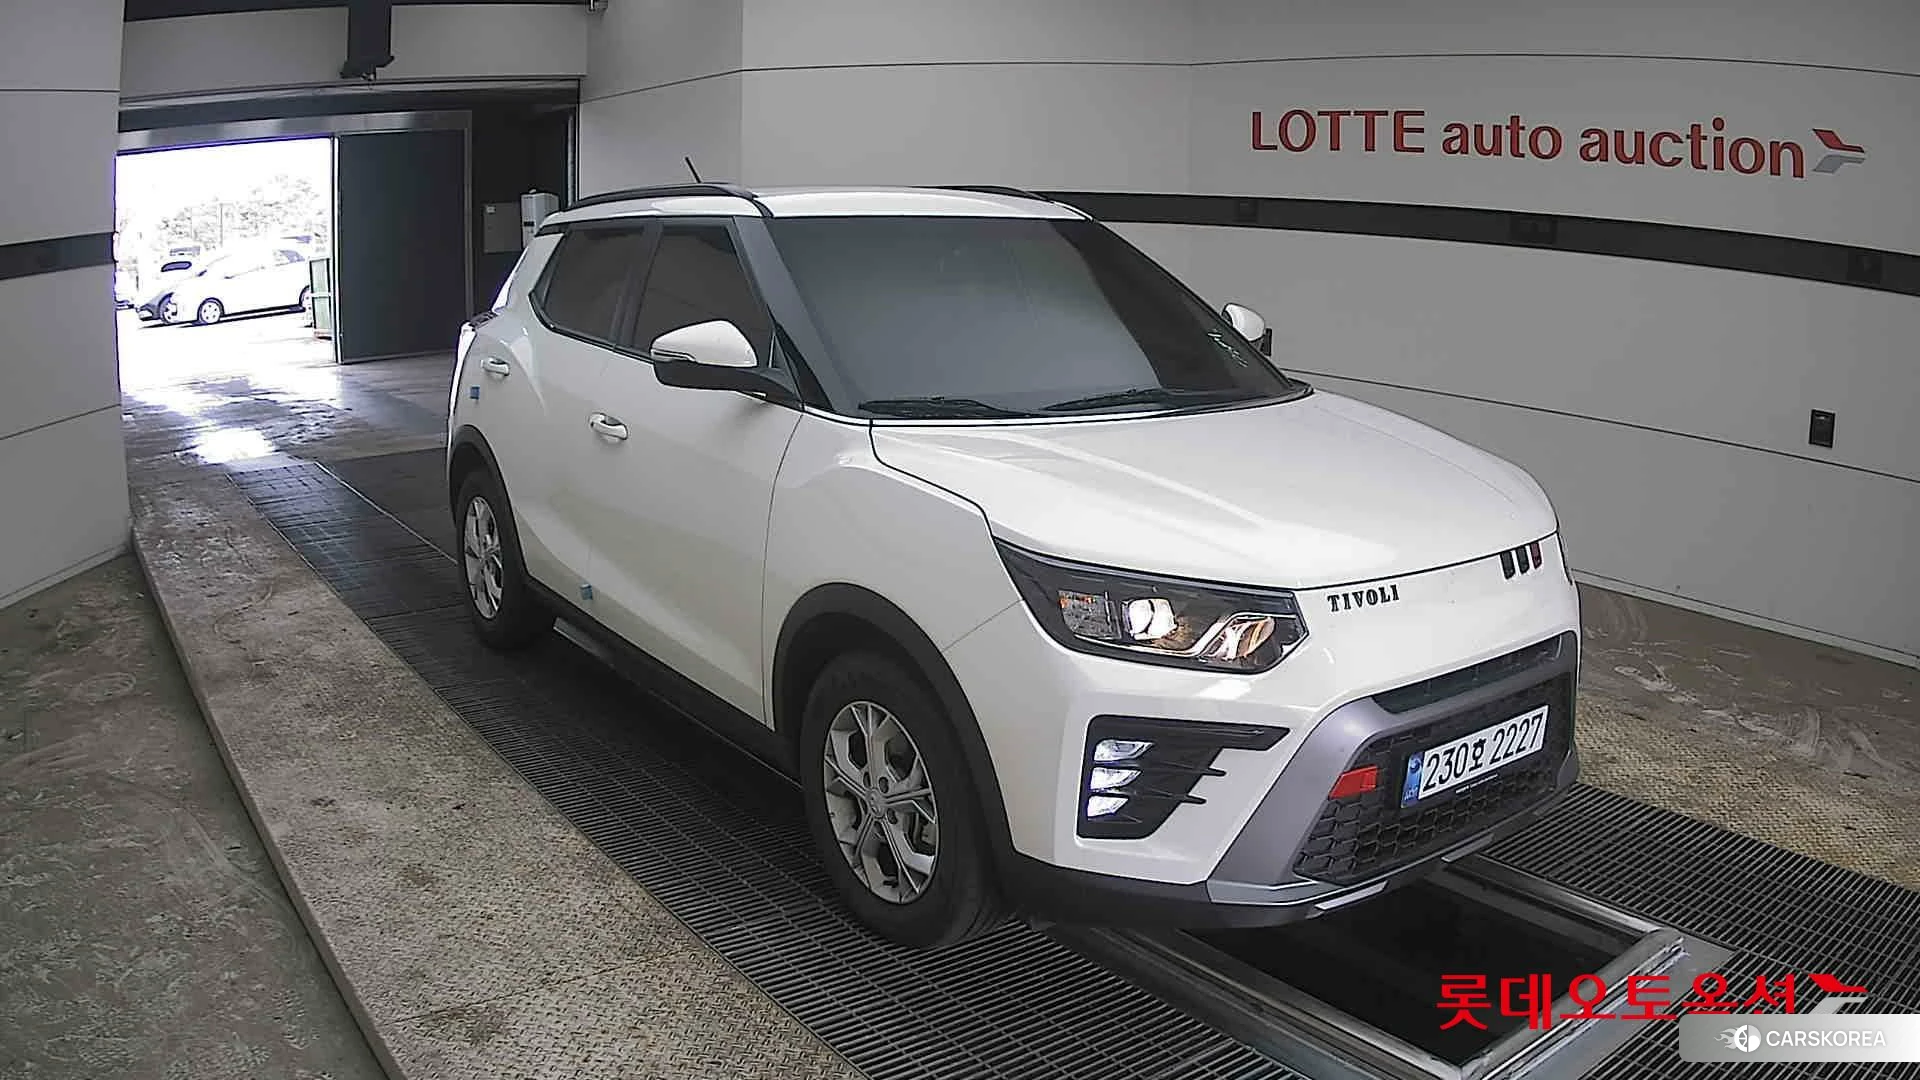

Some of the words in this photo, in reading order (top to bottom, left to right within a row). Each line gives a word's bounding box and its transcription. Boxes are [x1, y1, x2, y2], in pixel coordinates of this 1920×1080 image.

[1252, 109, 1425, 153] LOTTE
[1442, 115, 1563, 160] auto
[1579, 117, 1806, 178] auction
[1327, 584, 1399, 612] TIVOLI
[1489, 711, 1544, 765] 2227
